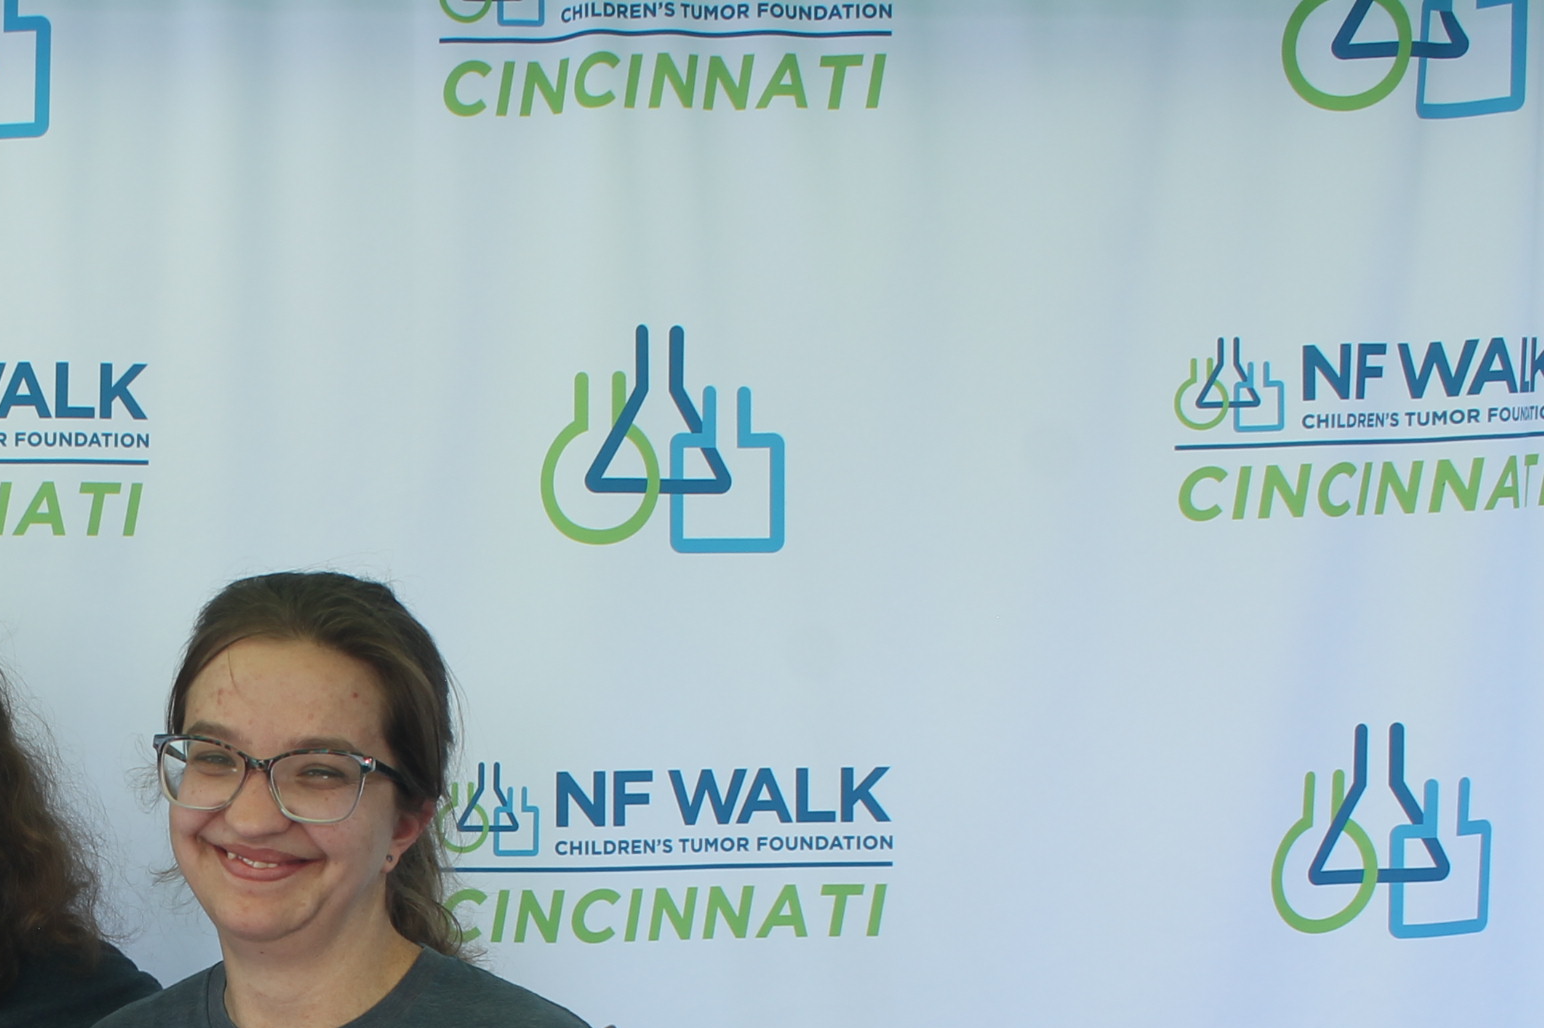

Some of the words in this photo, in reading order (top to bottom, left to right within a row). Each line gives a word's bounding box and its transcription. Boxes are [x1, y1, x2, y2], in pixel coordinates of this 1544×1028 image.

[561, 2, 675, 23] CHILDREN'S
[681, 3, 749, 20] TUMOR
[757, 3, 893, 20] FOUNDATION
[443, 51, 887, 117] CINCINNATI
[1302, 343, 1387, 401] NF
[1302, 411, 1400, 430] CHILDREN'S
[1404, 408, 1481, 427] TUMOR
[15, 432, 150, 449] FOUNDATION
[556, 770, 653, 827] NF
[668, 766, 891, 825] WALK
[555, 838, 673, 856] CHILDREN'S
[679, 837, 750, 854] TUMOR
[757, 835, 894, 852] FOUNDATION
[442, 883, 887, 944] CINCINNATI
